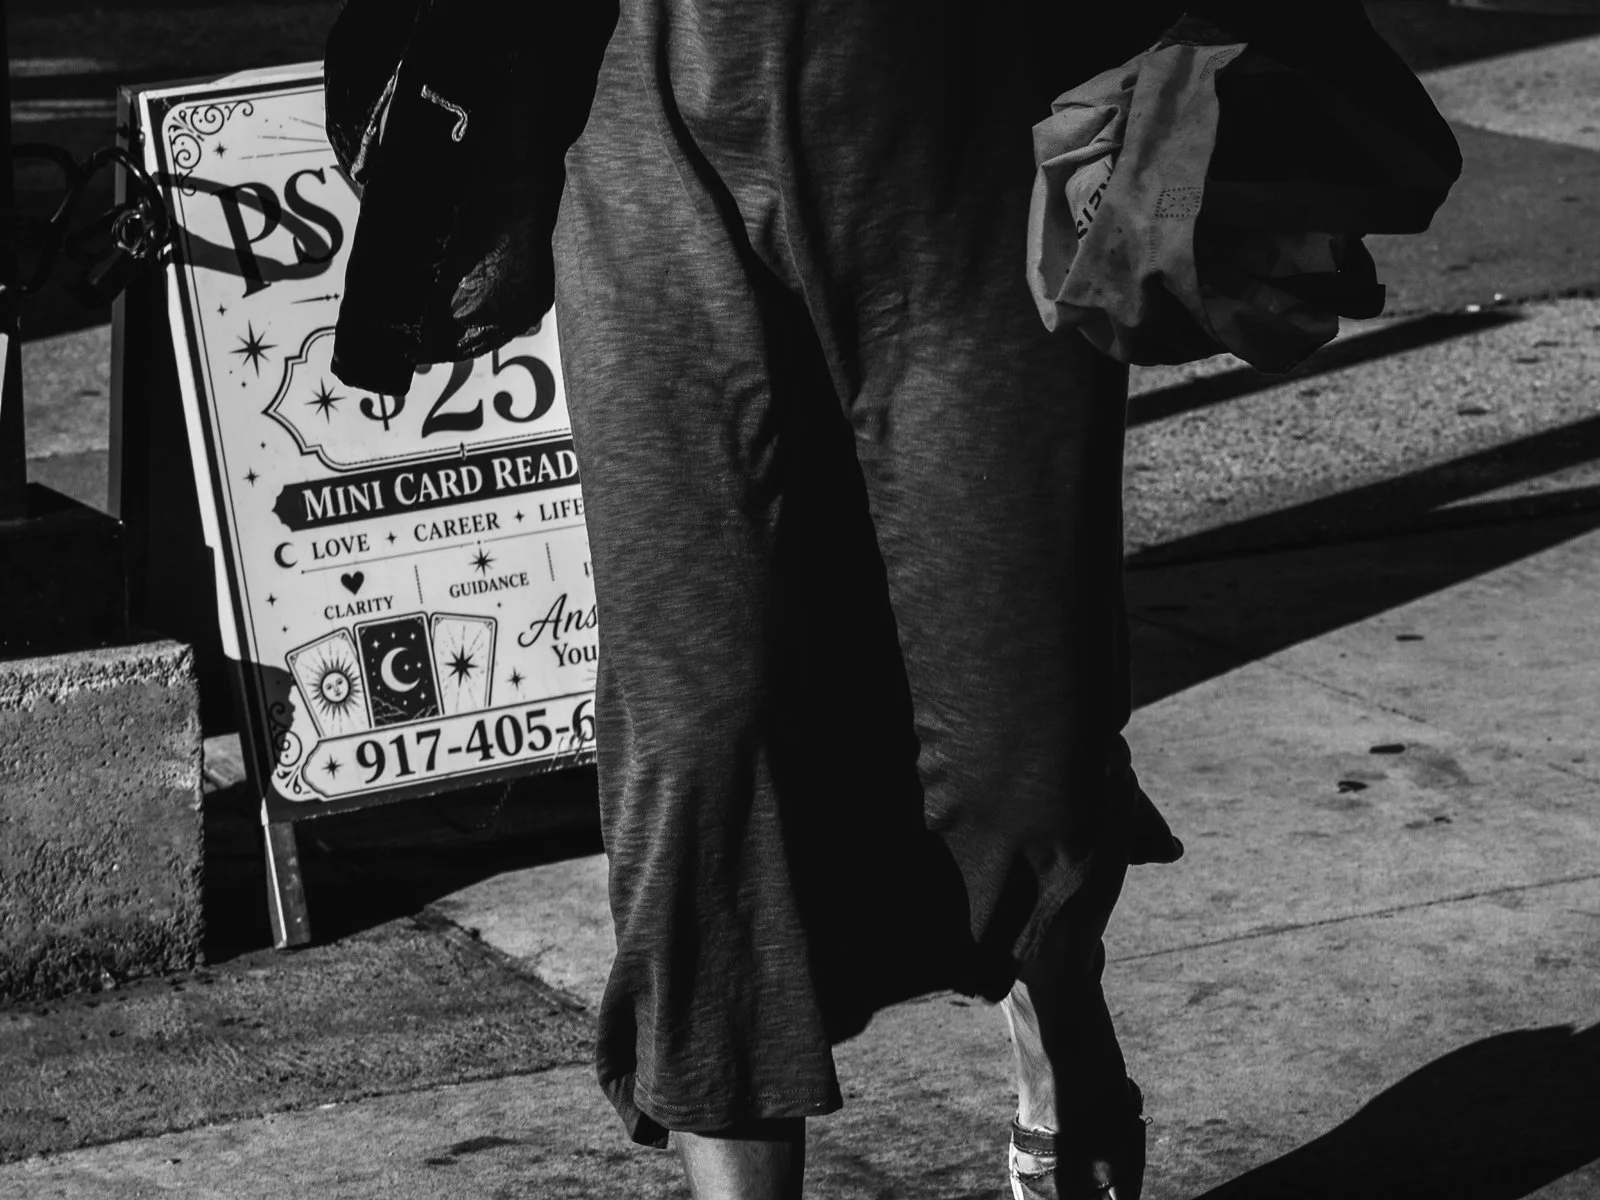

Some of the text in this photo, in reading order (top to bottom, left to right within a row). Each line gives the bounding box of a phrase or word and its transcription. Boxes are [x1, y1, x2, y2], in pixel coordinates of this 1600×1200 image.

[302, 449, 578, 522] MINI CARD READ
[312, 498, 584, 560] LOVE CAREER LIFE
[324, 595, 394, 621] CLARITY
[449, 572, 529, 599] GUIDANCE
[517, 593, 597, 647] Ans
[552, 643, 597, 667] You
[355, 699, 595, 784] 917-405-6
